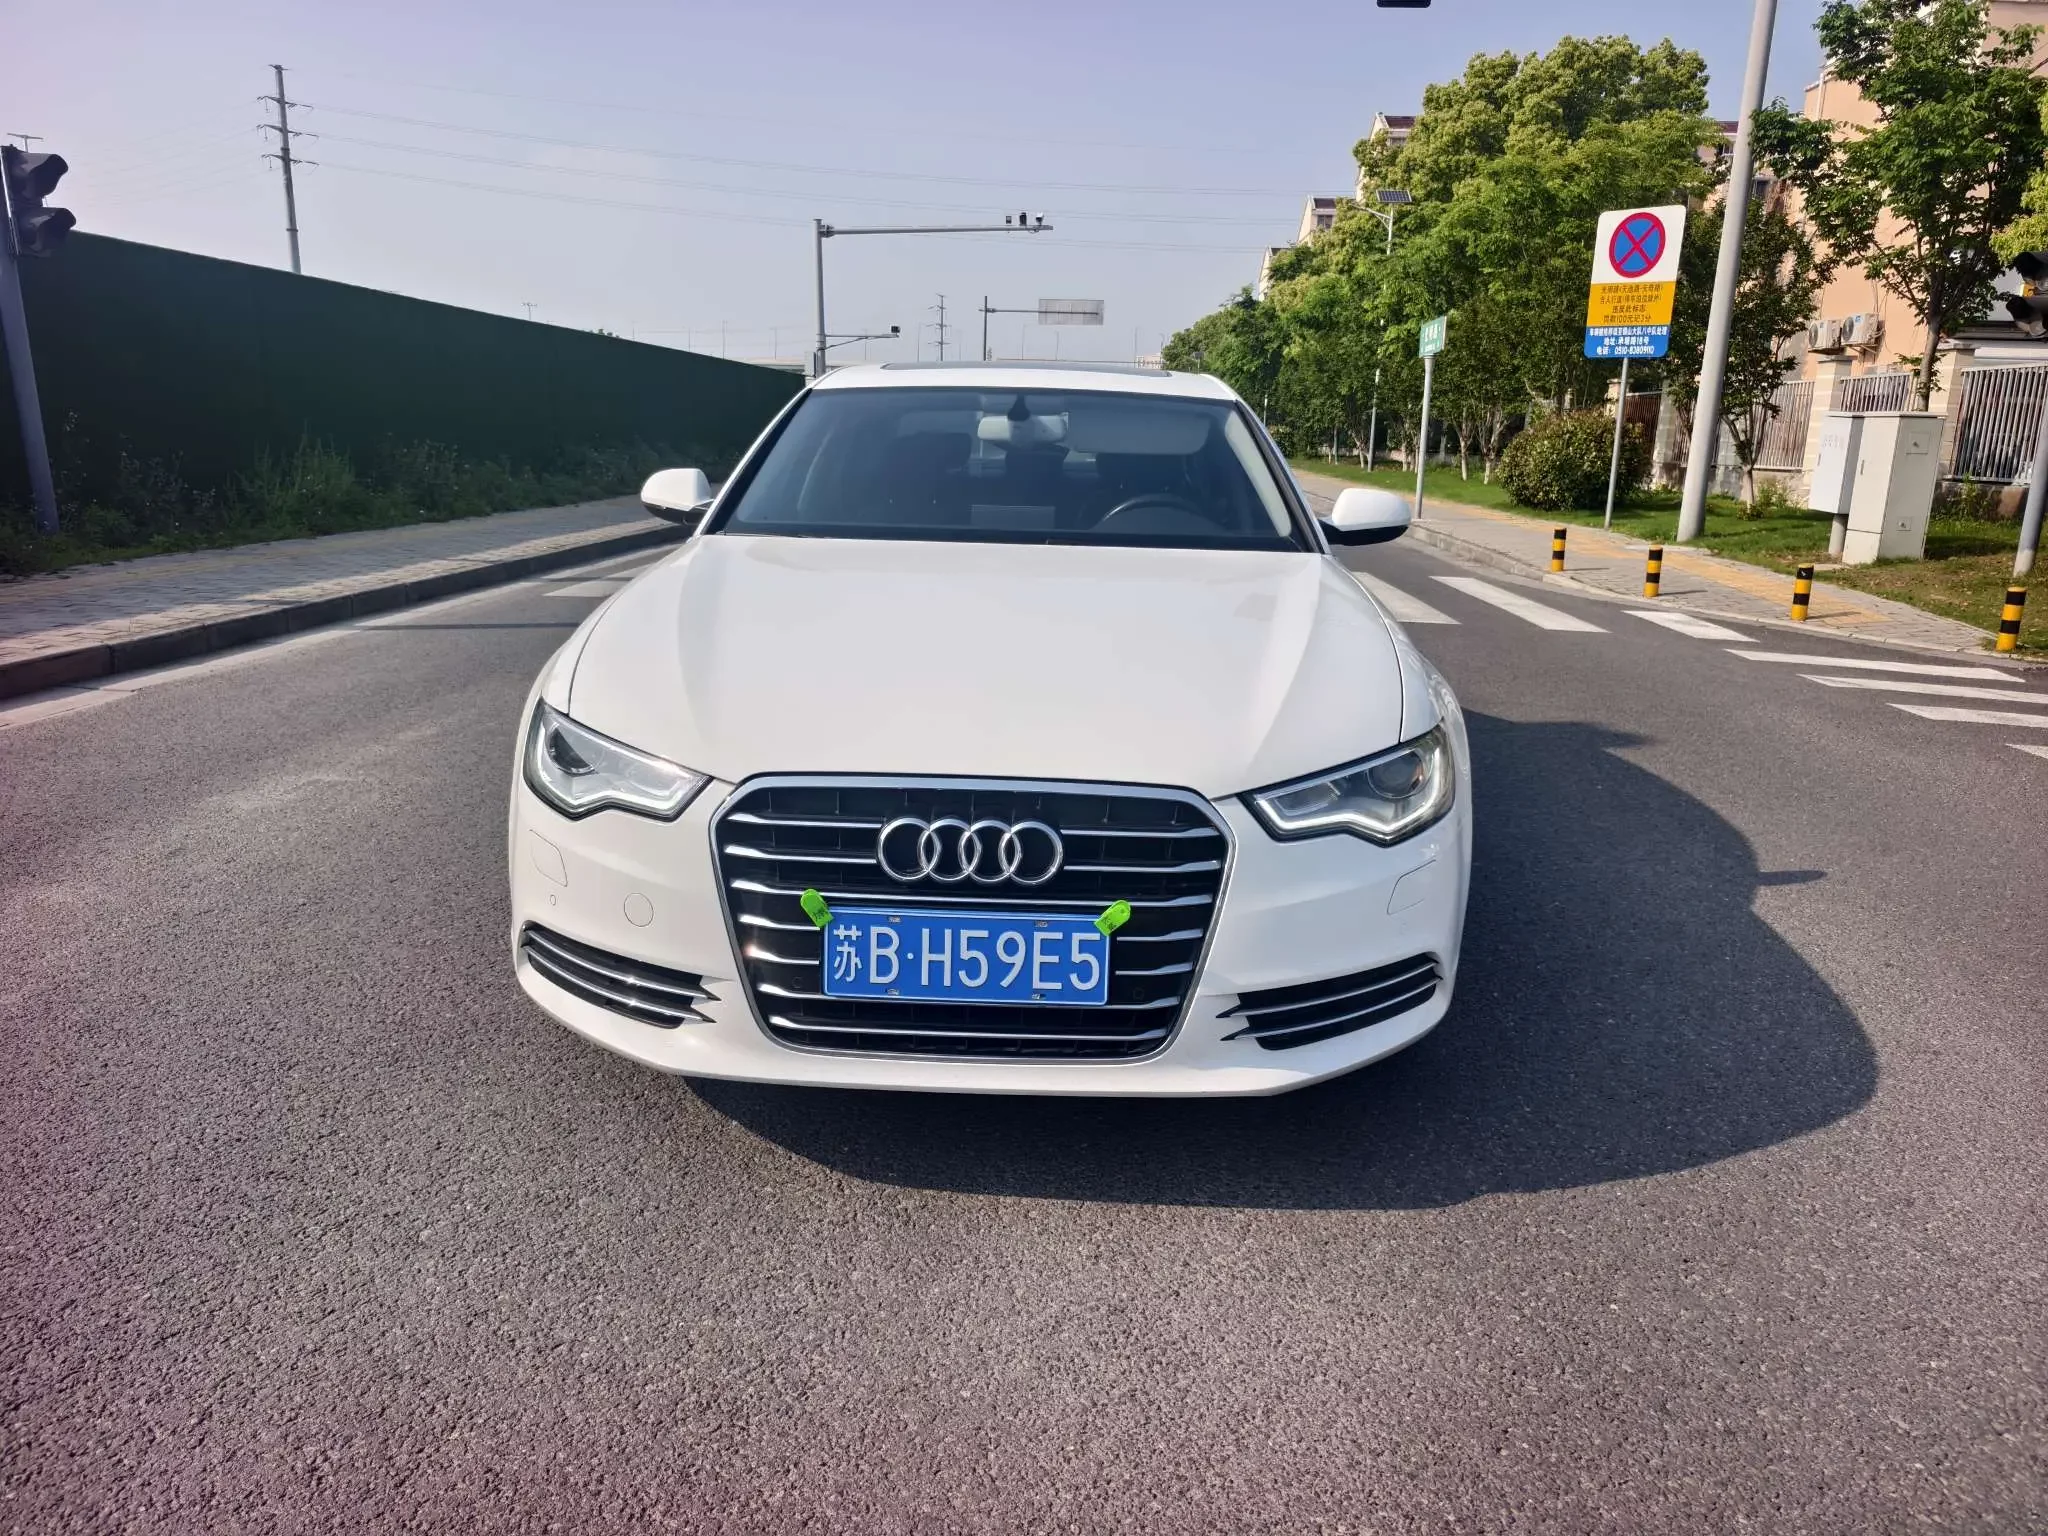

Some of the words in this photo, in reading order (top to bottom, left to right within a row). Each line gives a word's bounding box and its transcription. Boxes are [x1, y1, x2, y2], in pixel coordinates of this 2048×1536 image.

[1612, 304, 1647, 314] 违反此标志
